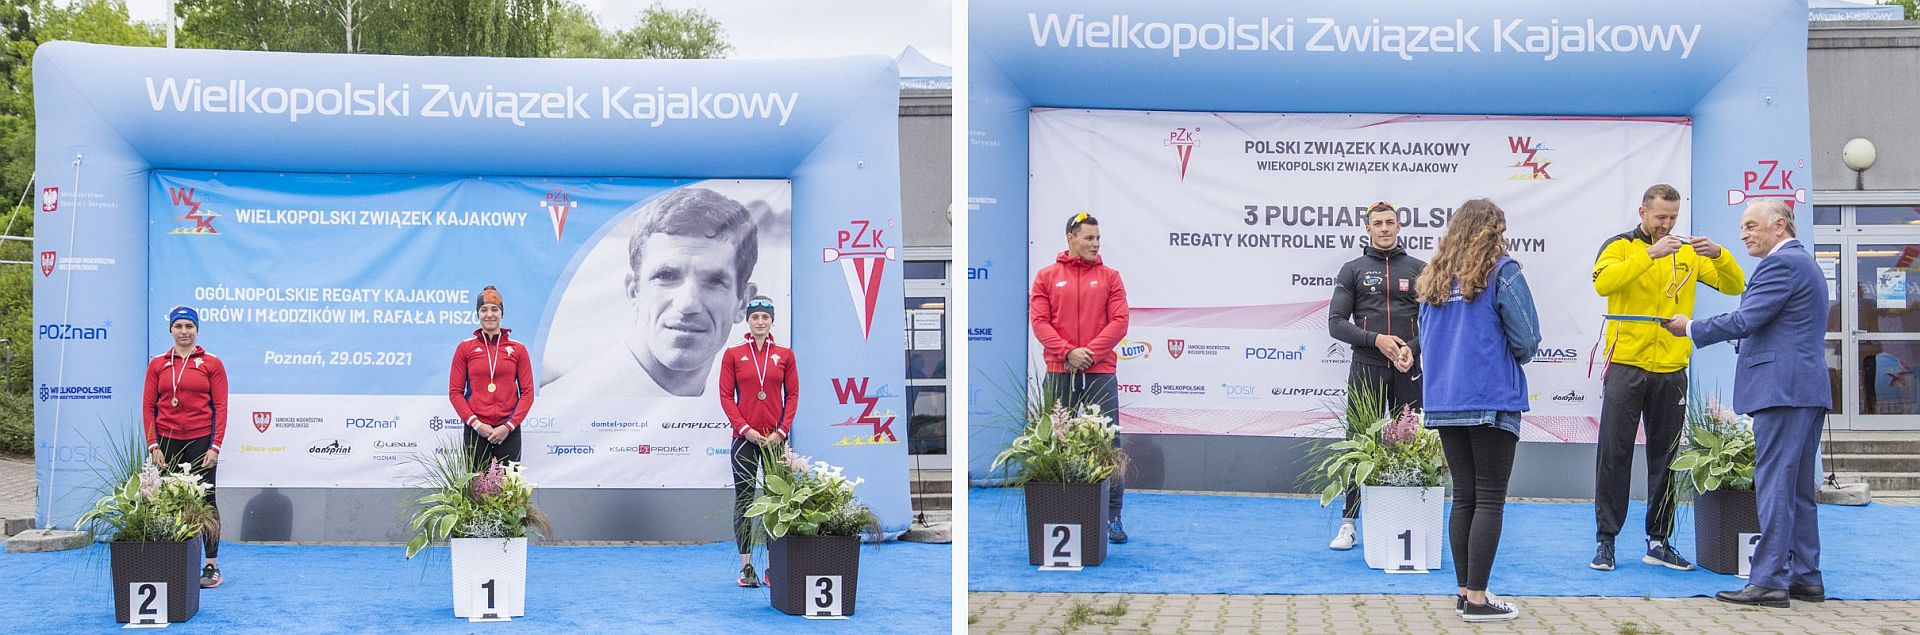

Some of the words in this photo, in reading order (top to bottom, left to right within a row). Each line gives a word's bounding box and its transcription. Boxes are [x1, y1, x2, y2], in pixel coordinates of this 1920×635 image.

[1028, 12, 1293, 57] Wielkopolski
[1305, 17, 1481, 61] Związek
[1493, 18, 1701, 61] Kajakowy
[145, 77, 409, 122] Wielkopolski
[421, 84, 591, 127] Związek
[602, 86, 799, 127] Kajakowy
[1170, 127, 1192, 141] PZK
[1244, 140, 1300, 154] POLSKI
[1304, 141, 1375, 158] ZWIĄZEK
[1380, 142, 1470, 156] KAJAKOWY
[1257, 161, 1334, 171] WIEKOPOLSKI
[1337, 162, 1389, 174] ZWIĄZEK
[1392, 162, 1458, 173] KAJAKOWY
[1744, 160, 1793, 191] PZK
[546, 188, 569, 202] PZK
[236, 208, 355, 225] WIELKOPOLSKI
[360, 210, 432, 228] ZWIĄZEK
[437, 211, 527, 227] KAJAKOWY
[1244, 205, 1259, 226] 3
[837, 219, 884, 249] PZK
[1169, 232, 1233, 247] REGATY
[1238, 234, 1336, 249] KONTROLNE
[1340, 235, 1355, 249] W
[195, 284, 319, 301] OGÓLNOPOLSKIE
[322, 287, 380, 302] REGATY
[385, 288, 469, 304] KAJAKOWE
[248, 308, 251, 322] I
[256, 306, 346, 323] MŁODZIKÓW
[351, 309, 369, 323] IM.
[374, 309, 436, 324] RAFAŁA
[40, 324, 107, 340] POZnan
[264, 350, 325, 367] Poznań,
[329, 351, 412, 366] 29.05.2021
[1121, 344, 1145, 356] LOTTO
[1245, 347, 1302, 360] POZnan
[50, 386, 112, 394] WIELKOPOLSKIE
[831, 377, 897, 442] WZK
[346, 418, 397, 429] POZnan
[591, 420, 648, 429] domtel-sport.pl
[1052, 525, 1071, 557] 2
[1398, 529, 1411, 560] 1
[138, 584, 157, 614] 2
[481, 579, 494, 609] 1
[815, 577, 833, 608] 3
